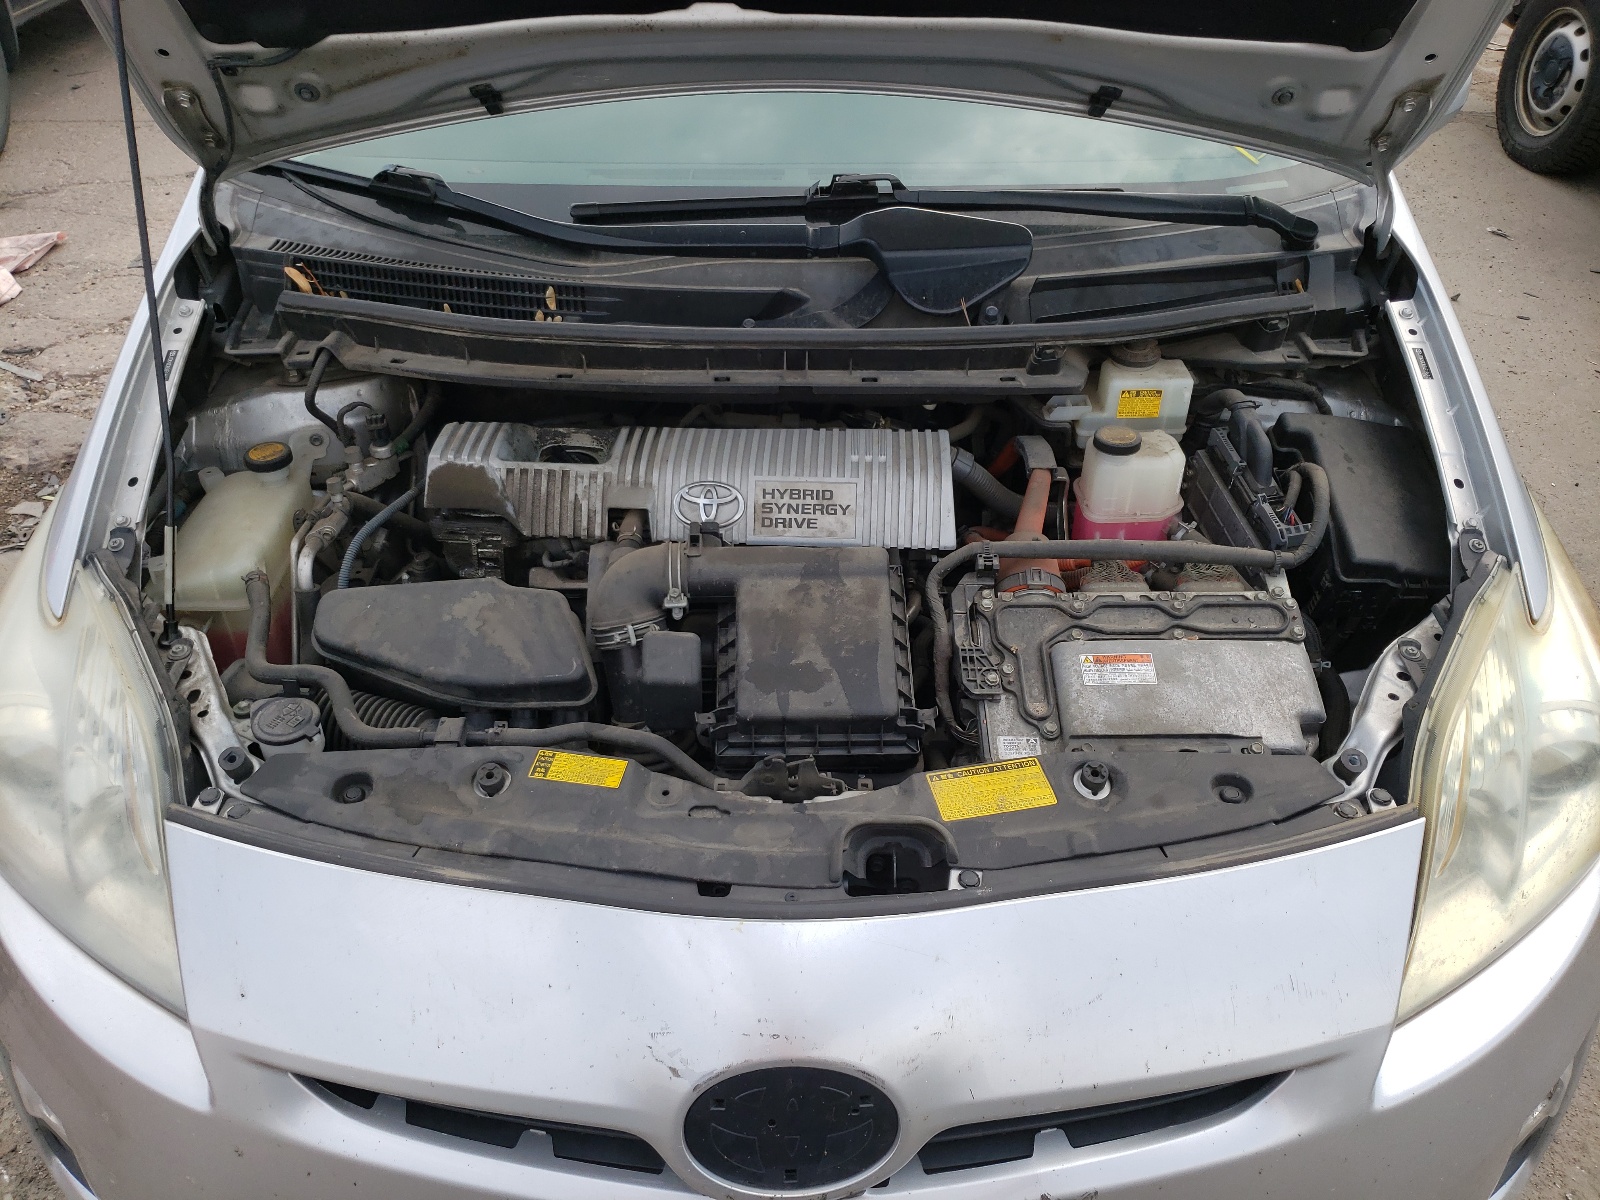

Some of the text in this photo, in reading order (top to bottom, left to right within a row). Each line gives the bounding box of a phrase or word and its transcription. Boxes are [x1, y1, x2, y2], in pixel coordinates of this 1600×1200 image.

[762, 489, 833, 500] HYBRID
[761, 503, 851, 515] SYNERGY
[761, 517, 818, 529] DRIVE
[957, 767, 990, 778] CAUTION
[993, 760, 1036, 772] ATTENTION
